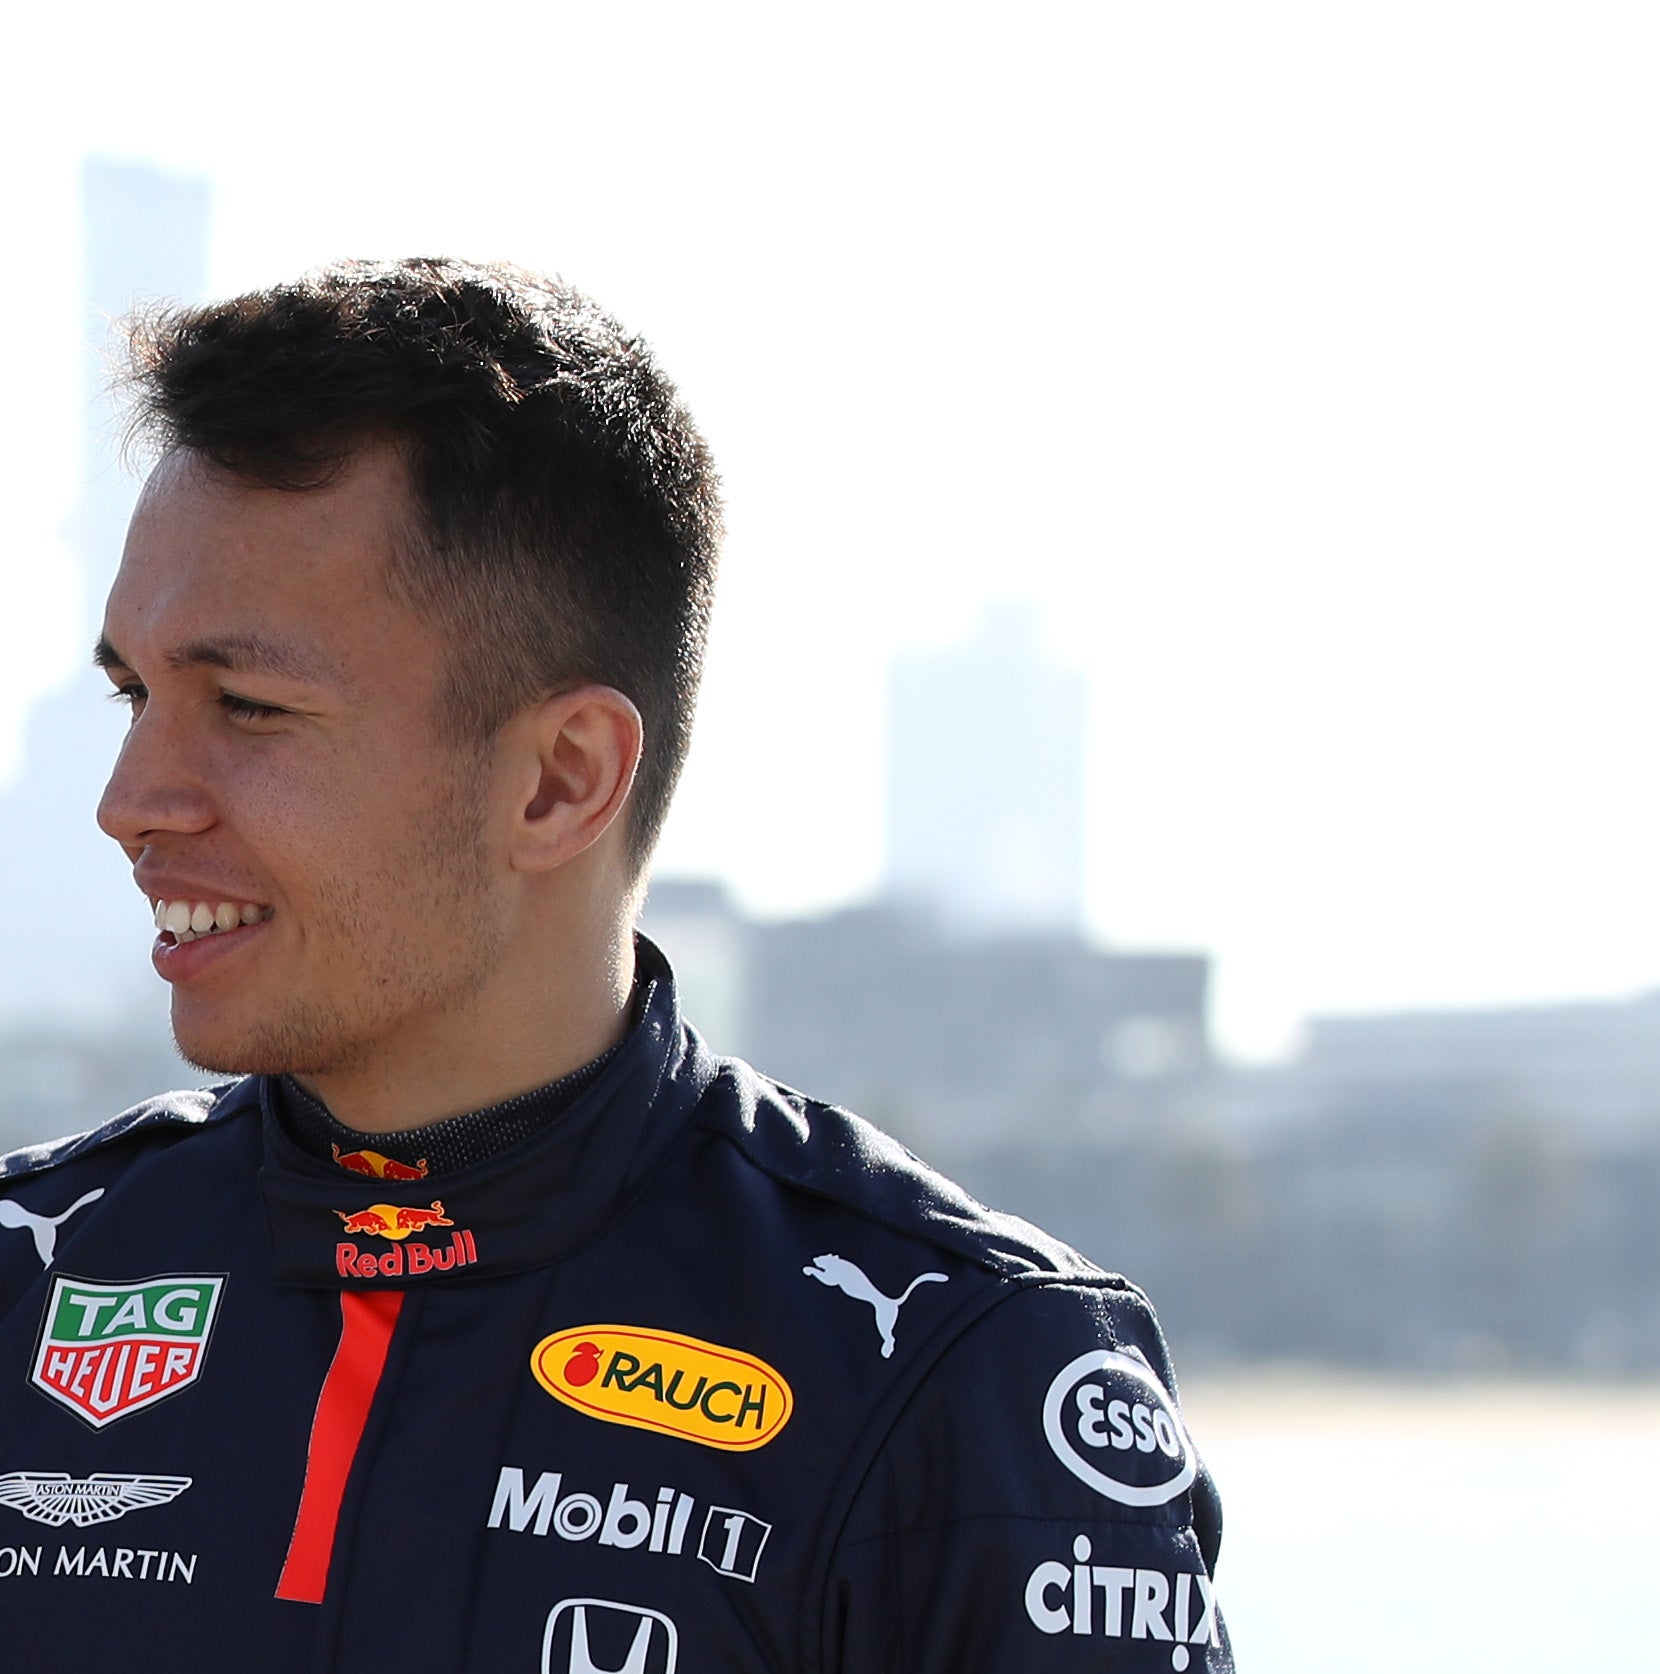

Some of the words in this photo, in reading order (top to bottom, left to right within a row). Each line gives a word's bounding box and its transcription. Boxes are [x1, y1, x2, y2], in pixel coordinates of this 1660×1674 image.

[335, 1242, 403, 1278] Red
[407, 1229, 478, 1275] Bull
[70, 1288, 201, 1338] TAG
[44, 1344, 194, 1408] HEUER
[600, 1350, 768, 1431] RAUCH
[37, 1483, 73, 1496] ASTON
[74, 1483, 120, 1497] MARTIN
[487, 1465, 695, 1555] Mobil
[53, 1545, 198, 1585] MARTIN
